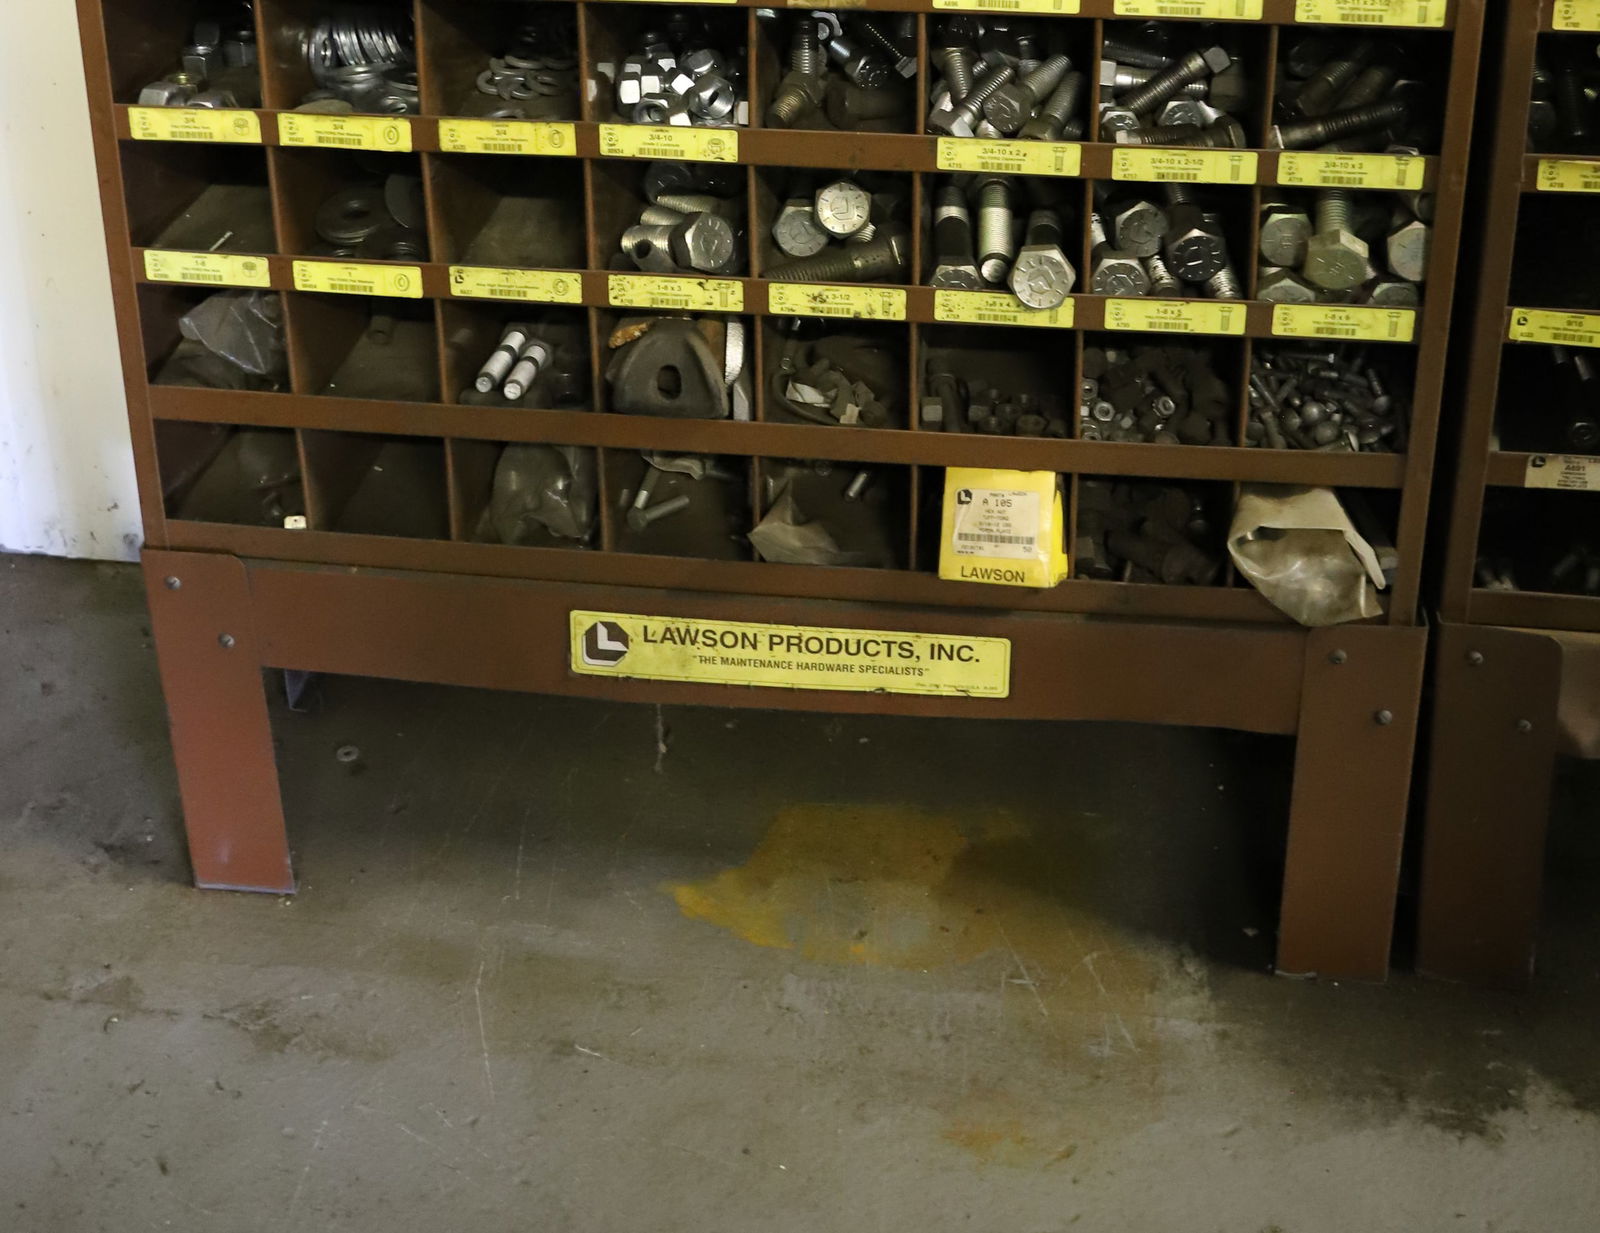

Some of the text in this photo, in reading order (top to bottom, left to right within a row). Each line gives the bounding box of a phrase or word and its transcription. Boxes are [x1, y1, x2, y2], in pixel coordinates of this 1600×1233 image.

[1370, 0, 1392, 8] 2-1/2
[649, 133, 674, 143] 3/4-10
[981, 147, 1008, 157] 3/4-10
[1150, 157, 1176, 166] 3/4-10
[1184, 158, 1205, 167] 2-1/2
[1323, 160, 1351, 170] 3/4-10
[995, 499, 1013, 508] 105
[961, 565, 1026, 583] LAWSON
[643, 624, 981, 663] LAWSON PRODUCTS, INC.
[720, 656, 793, 670] MAINTENANCE
[796, 661, 855, 674] HARDWARE
